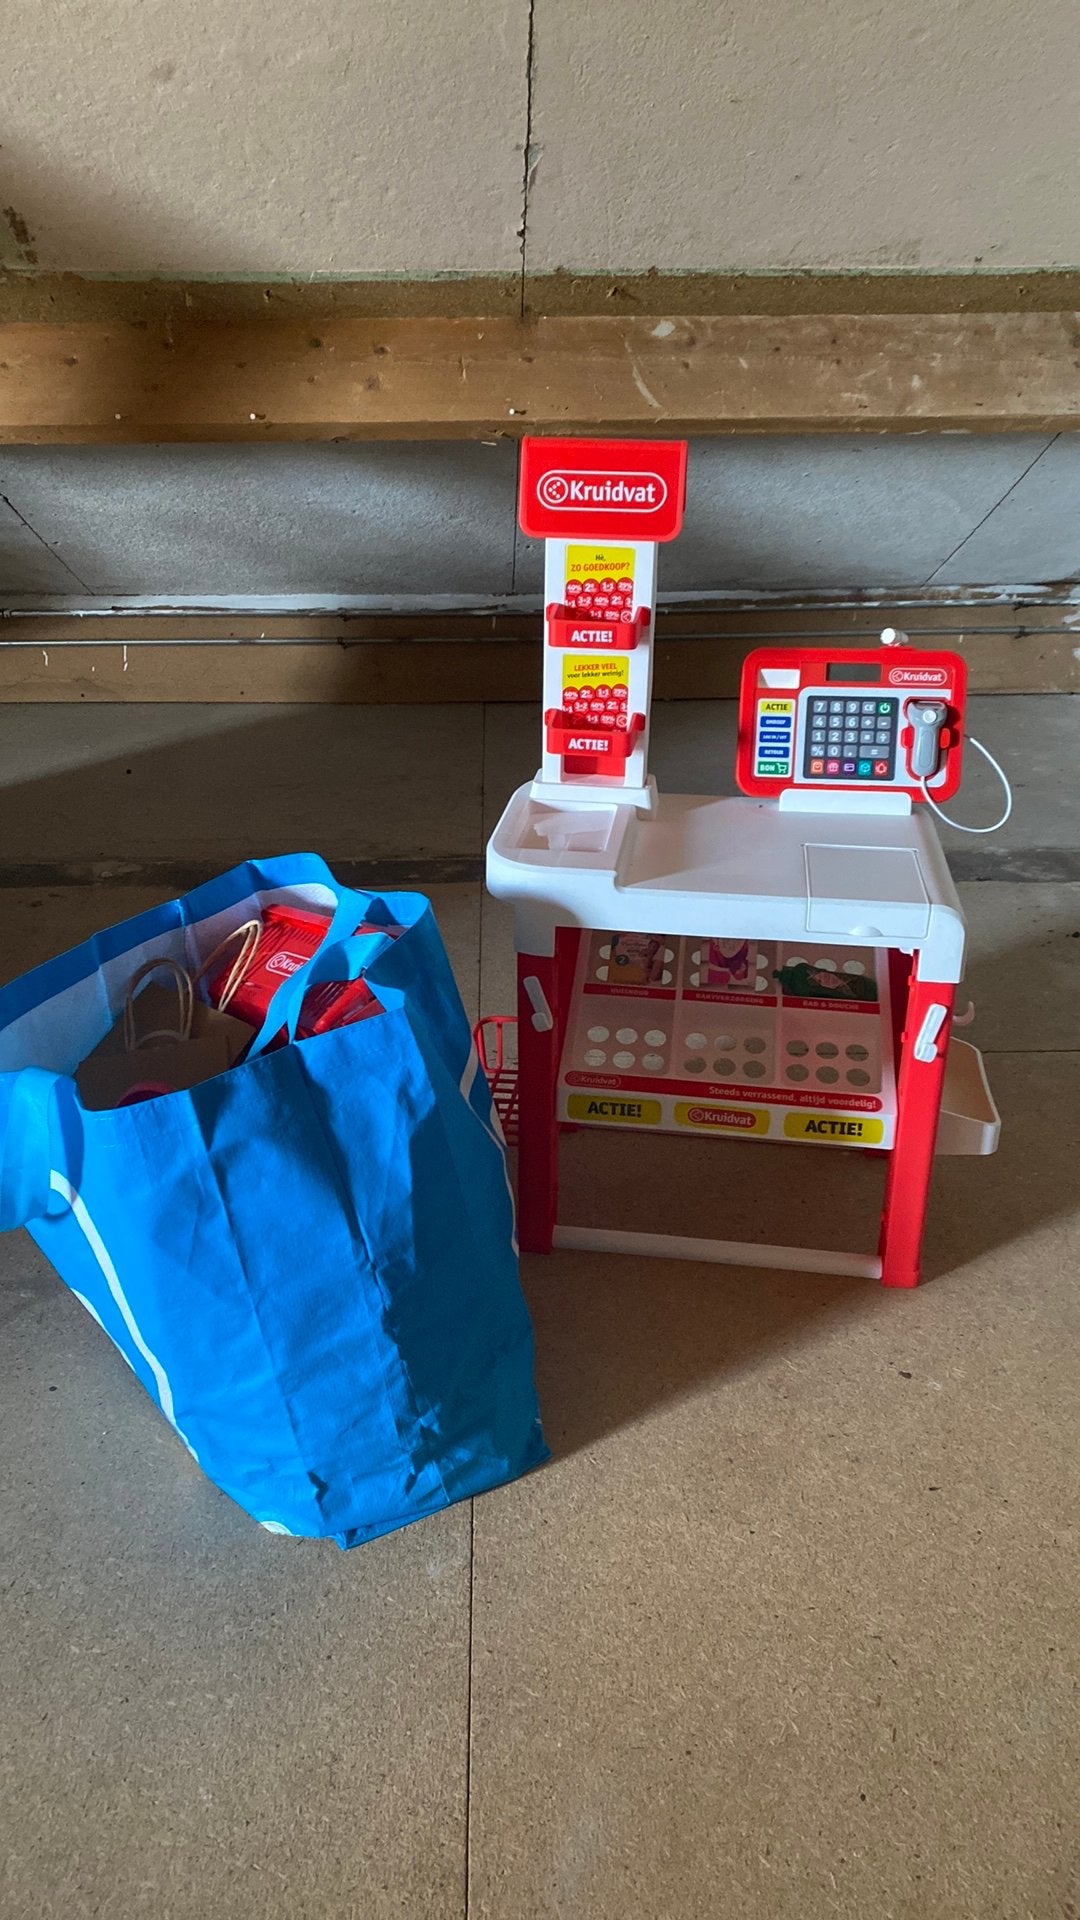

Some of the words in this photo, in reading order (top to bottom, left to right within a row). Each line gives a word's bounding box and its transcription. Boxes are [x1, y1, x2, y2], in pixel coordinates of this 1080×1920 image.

[570, 480, 656, 503] Kruidvat
[571, 564, 581, 572] ZO
[583, 562, 630, 572] GOEDKOOP?
[571, 630, 613, 643] ACTIE!
[602, 662, 617, 670] VEEL
[904, 672, 943, 682] Kruidvat
[766, 703, 788, 711] ACTIE
[817, 702, 824, 712] 7
[833, 702, 841, 712] 8
[849, 703, 857, 712] 9
[815, 717, 823, 726] 4
[832, 717, 840, 726] 5
[848, 717, 856, 727] 6
[815, 732, 822, 741] 1
[831, 732, 839, 741] 2
[847, 732, 855, 741] 3
[568, 738, 609, 751] ACTIE!
[831, 746, 838, 755] 0
[760, 764, 775, 772] BON
[581, 1075, 617, 1086] Kruidvat
[709, 1086, 741, 1097] Steeds
[742, 1090, 796, 1103] verrassend,
[799, 1095, 826, 1106] altijd
[828, 1097, 877, 1109] voordelig!
[587, 1101, 642, 1118] ACTIE!
[704, 1111, 753, 1126] Kruidvat
[805, 1120, 863, 1137] ACTIE!
